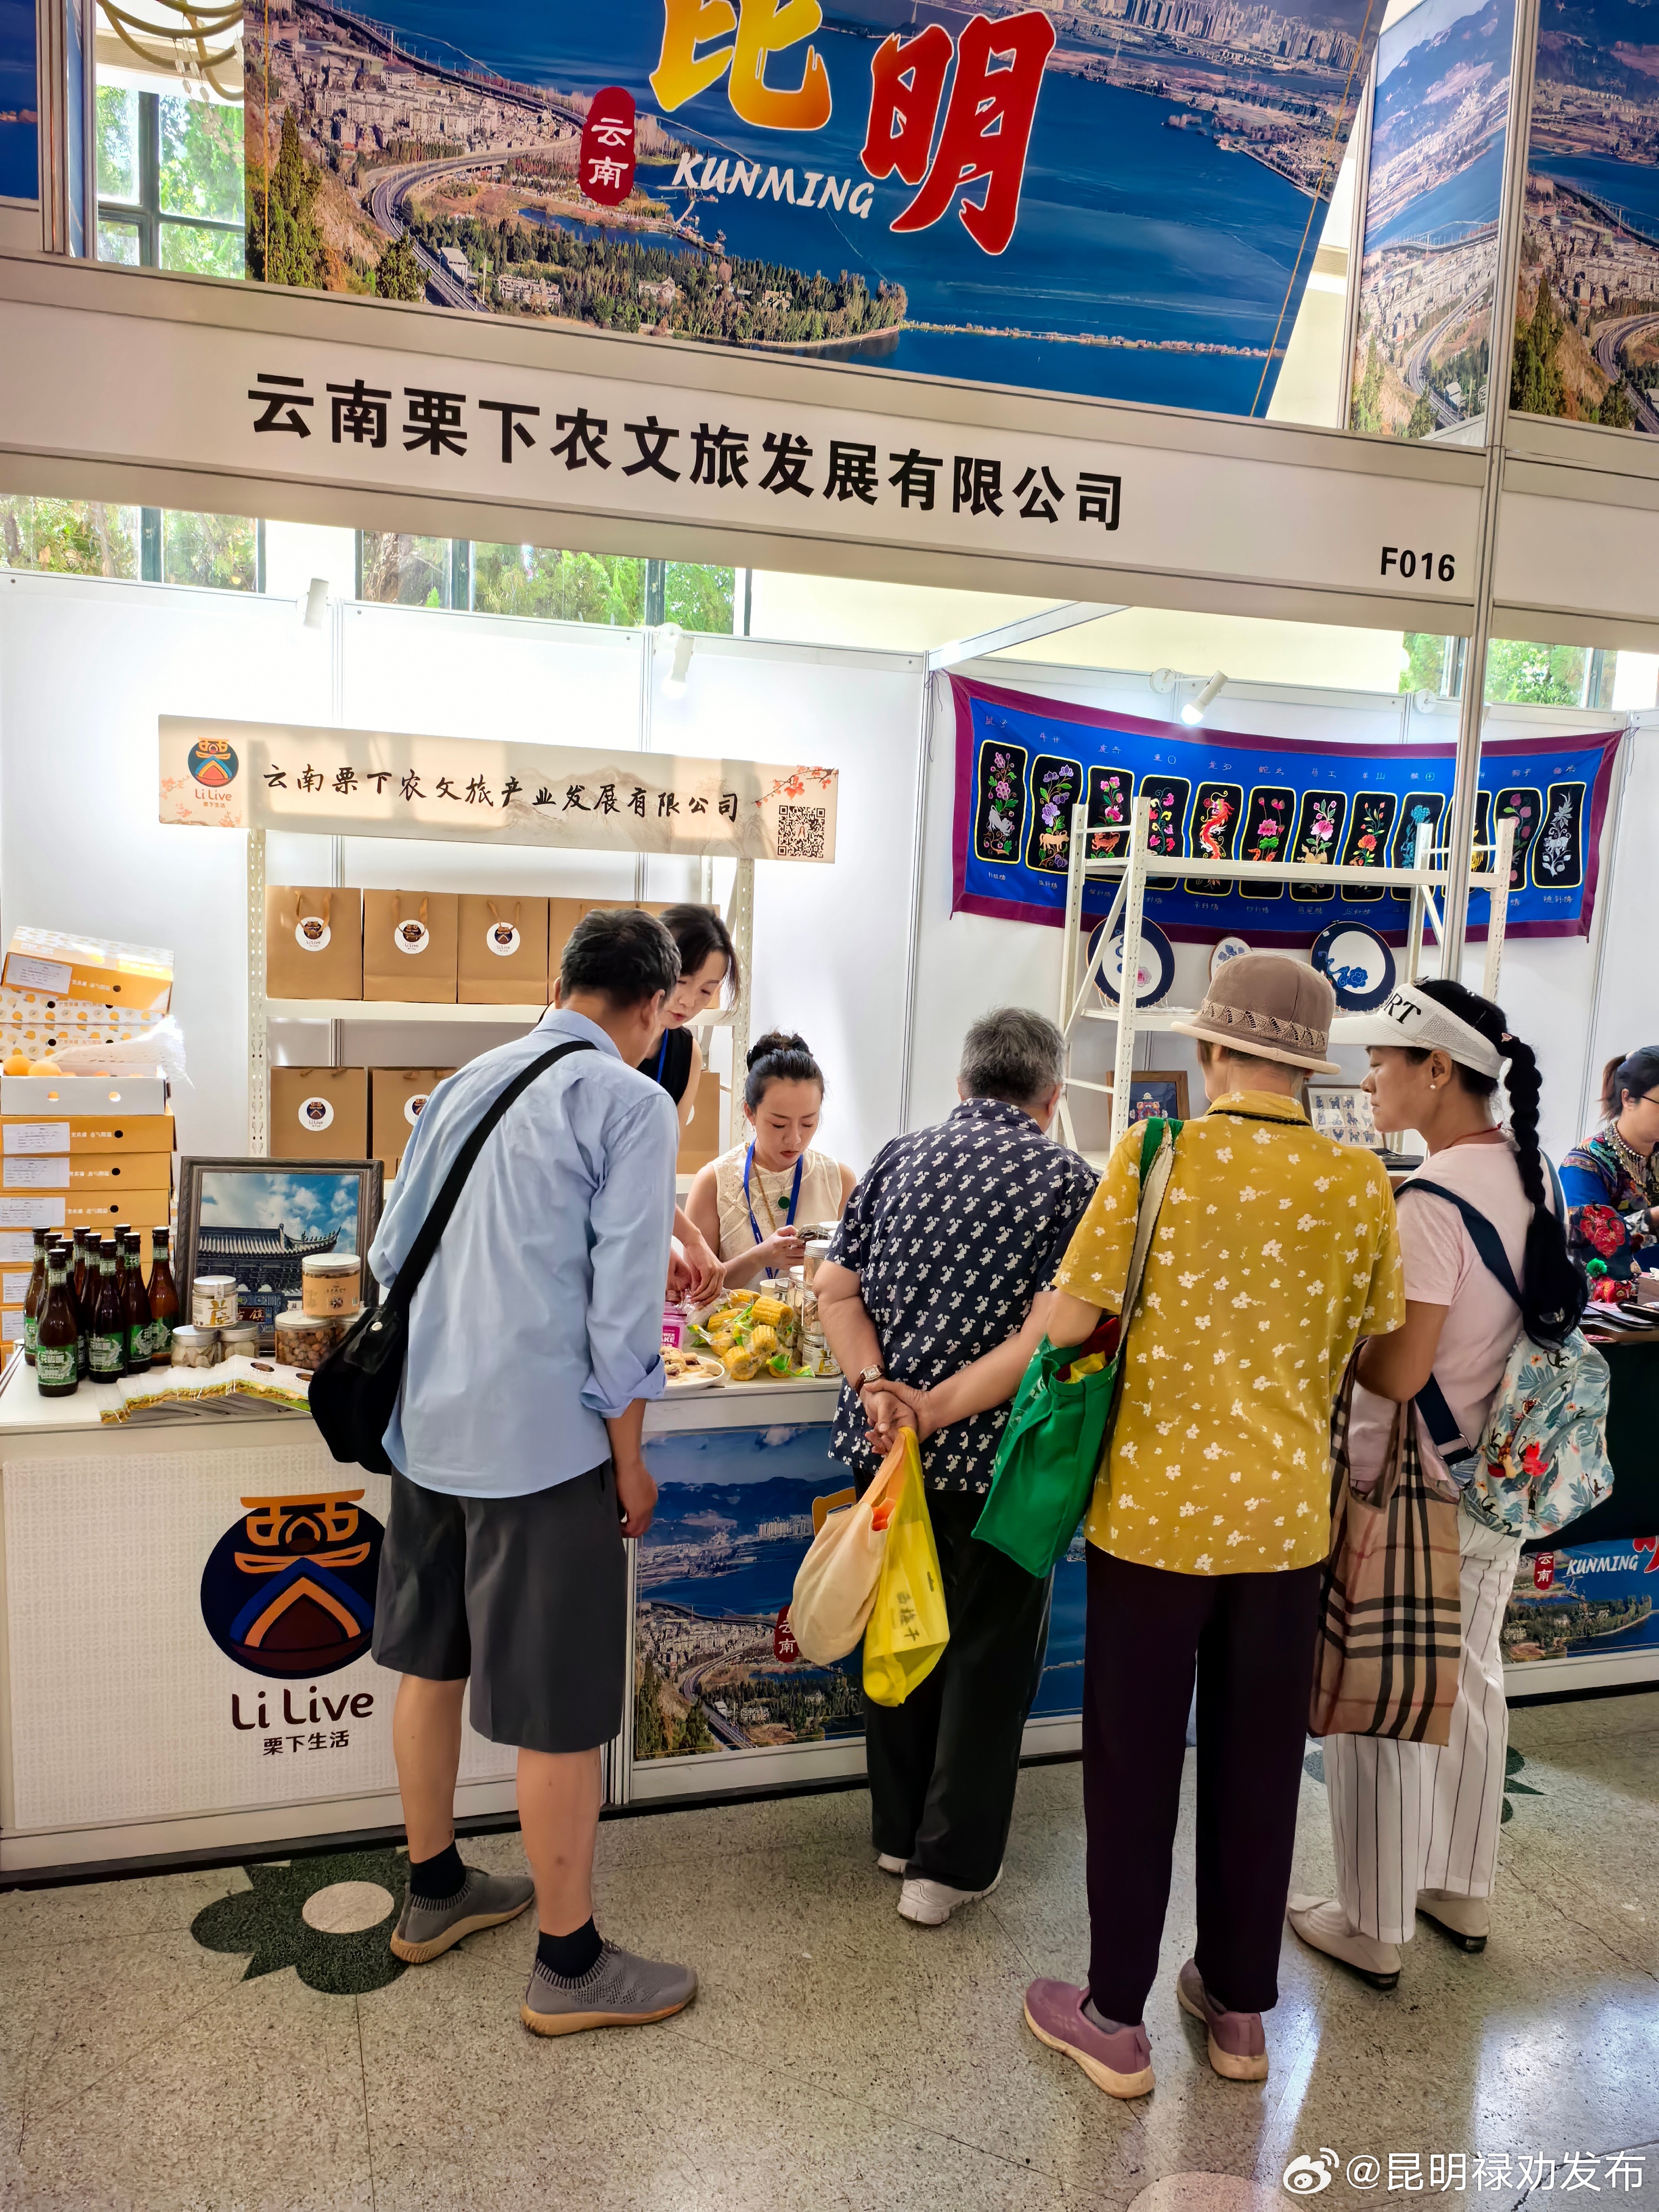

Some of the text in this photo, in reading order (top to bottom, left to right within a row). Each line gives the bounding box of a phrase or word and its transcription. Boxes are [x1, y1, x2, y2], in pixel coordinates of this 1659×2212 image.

[589, 117, 633, 190] 云南
[672, 152, 875, 219] KUNMING
[248, 373, 1122, 531] 云南栗下农文旅发展有限公司
[1380, 546, 1455, 582] F016
[195, 789, 232, 801] Li Live
[263, 764, 738, 822] 云南栗下农文旅产业发展有限公司
[1384, 993, 1421, 1024] RT
[1566, 1554, 1639, 1575] KUNMING
[232, 1686, 374, 1730] Li Live
[262, 1730, 350, 1756] 栗下生活
